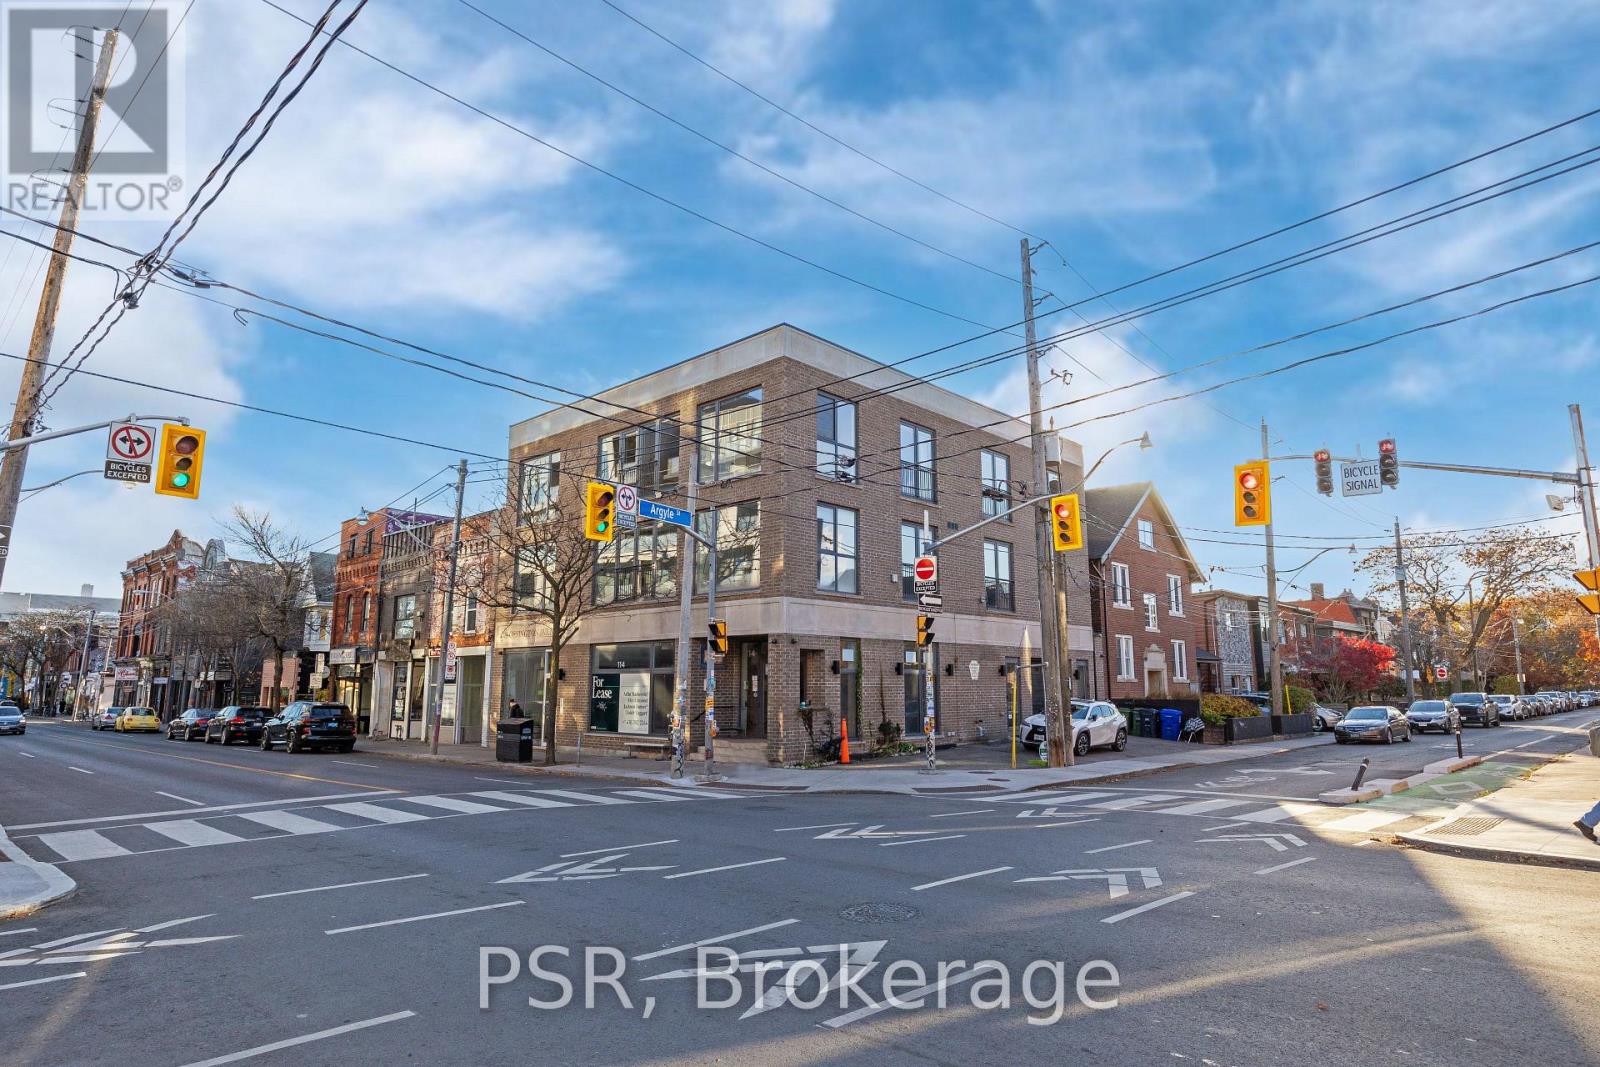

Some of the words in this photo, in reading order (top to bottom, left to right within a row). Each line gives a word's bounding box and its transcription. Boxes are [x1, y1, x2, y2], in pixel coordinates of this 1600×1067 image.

[111, 463, 147, 473] BICYCLES
[1344, 465, 1379, 478] BICYCLE
[107, 471, 148, 480] EXCEPTED
[1346, 479, 1379, 491] SIGNAL
[650, 504, 674, 519] Argyle
[592, 675, 604, 687] For
[592, 688, 613, 699] Lease
